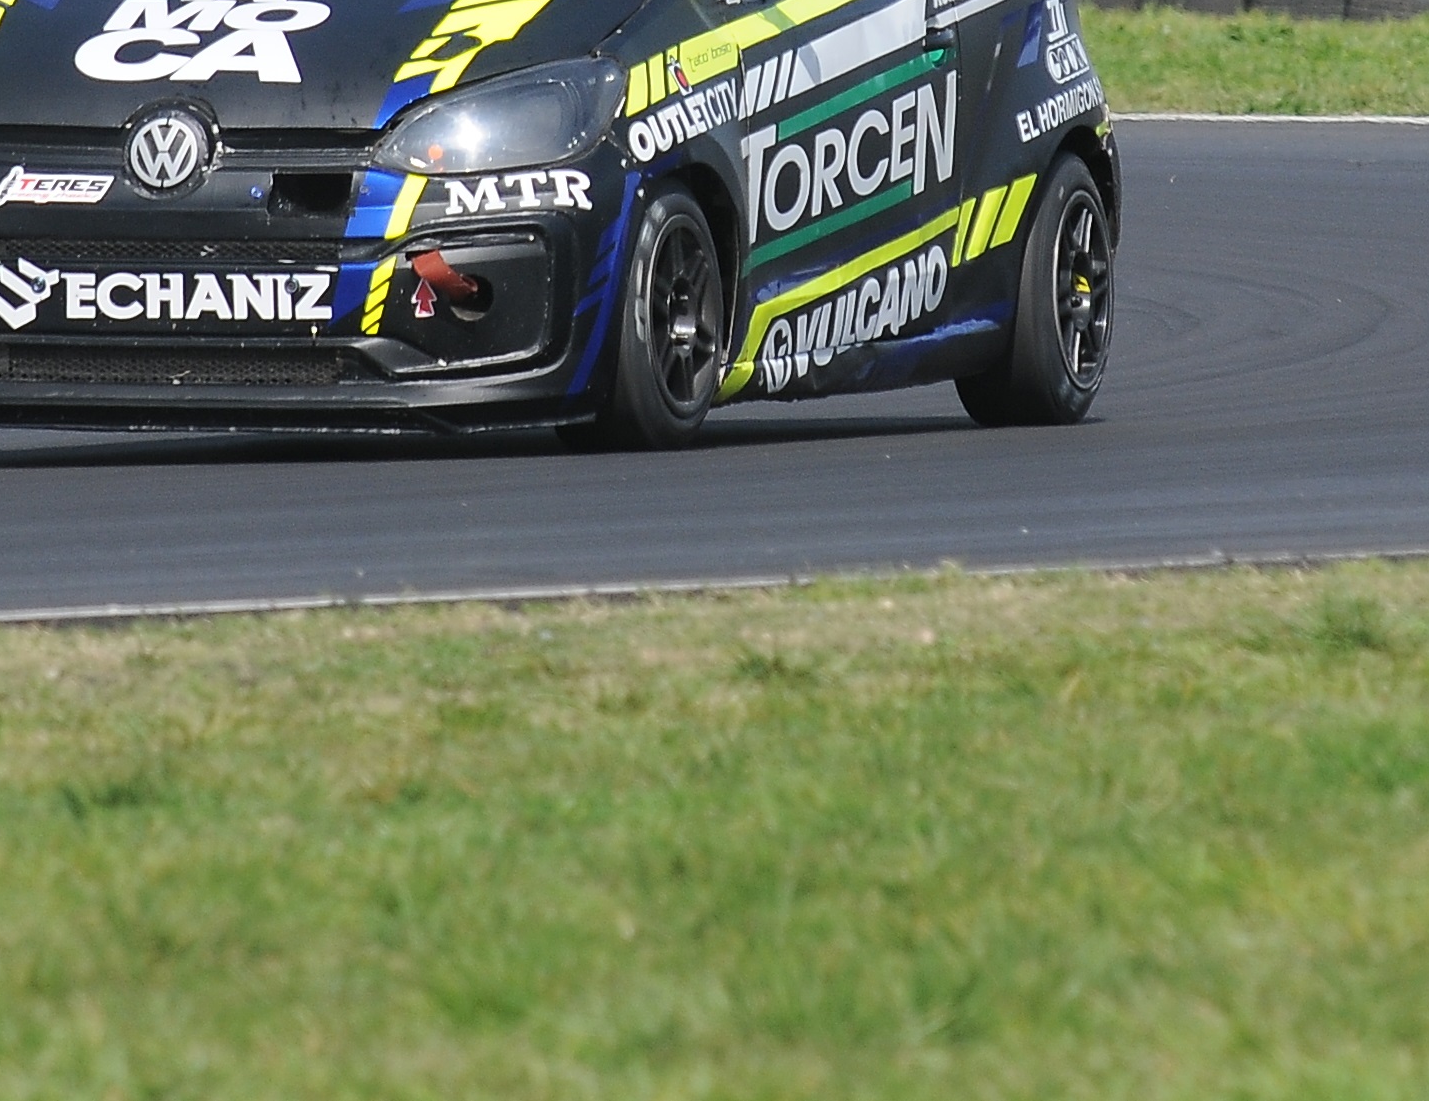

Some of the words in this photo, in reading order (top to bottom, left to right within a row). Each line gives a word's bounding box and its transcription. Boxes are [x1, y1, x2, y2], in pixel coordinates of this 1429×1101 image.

[1015, 109, 1041, 144] EL
[1035, 76, 1097, 133] HORMIGON
[19, 178, 108, 193] TERES
[740, 69, 958, 244] TORCEN
[444, 168, 594, 218] MTR
[792, 244, 949, 381] VULCANO
